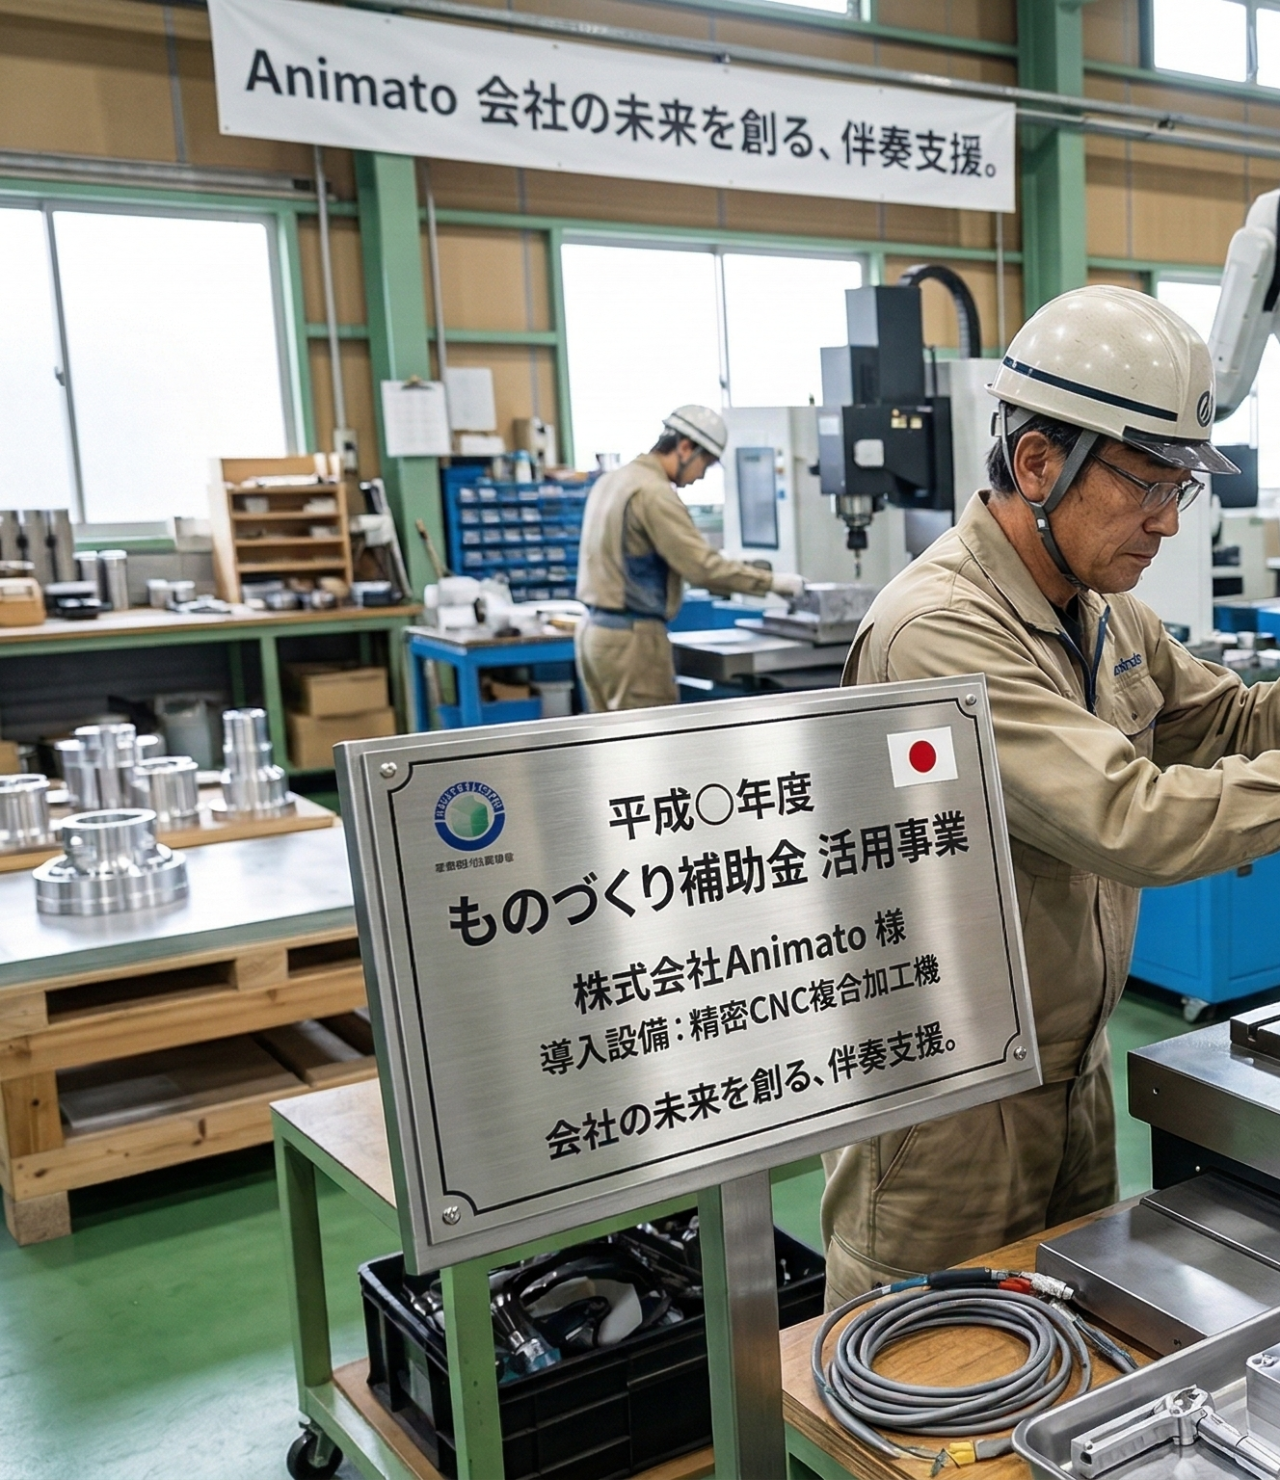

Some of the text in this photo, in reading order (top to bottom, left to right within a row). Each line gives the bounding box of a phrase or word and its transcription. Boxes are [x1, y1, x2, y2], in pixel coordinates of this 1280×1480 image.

[246, 49, 997, 178] Animato 会社の未来を創る、伴奏支援。
[448, 810, 970, 947] ものづくり補助金 活用事業
[572, 907, 907, 1015] 株式会社Animato 様
[544, 1020, 956, 1161] 会社の未来を創る、伴奏支援。
